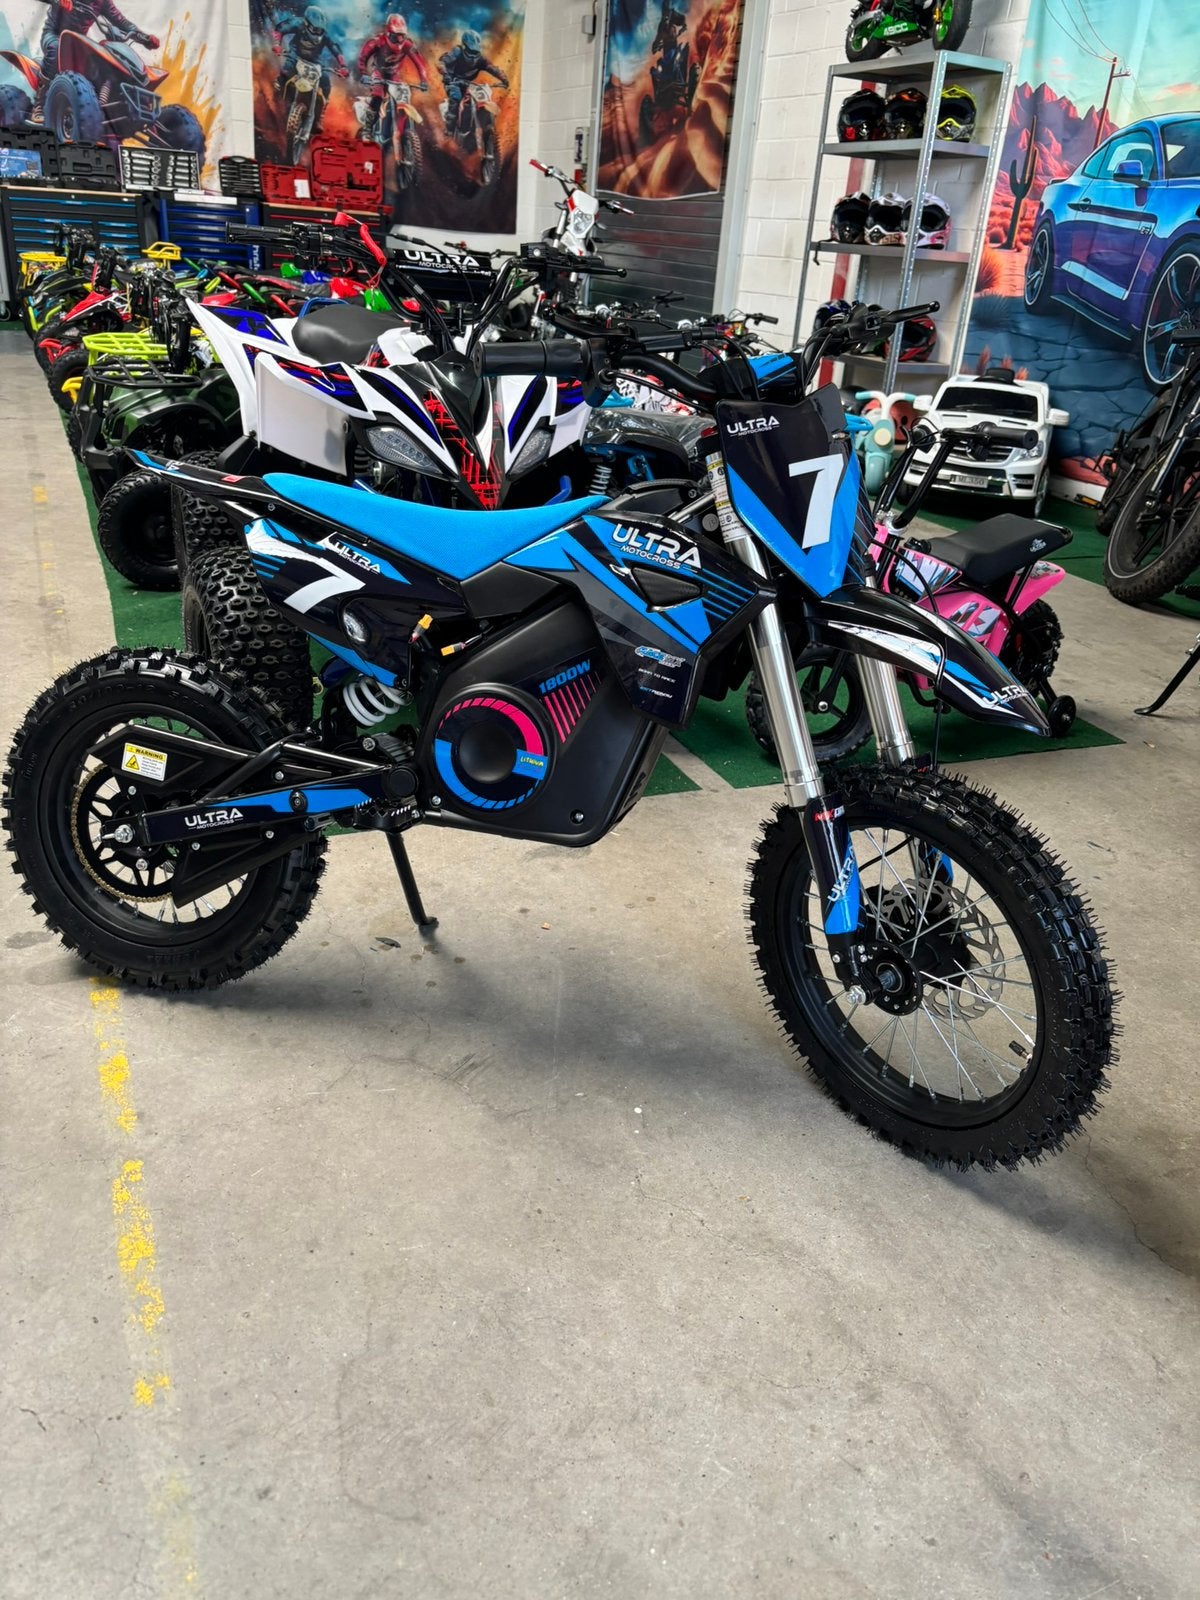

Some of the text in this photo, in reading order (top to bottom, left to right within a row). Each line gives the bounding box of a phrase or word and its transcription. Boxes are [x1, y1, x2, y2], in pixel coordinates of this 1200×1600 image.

[403, 249, 480, 267] ULTRA
[726, 415, 780, 434] ULTRA
[738, 426, 773, 437] MOTOCROSS
[788, 453, 844, 549] 7
[612, 523, 702, 569] ULTRA
[333, 541, 381, 573] ULTRA
[620, 545, 682, 570] MOTOCROSS
[539, 658, 591, 695] 1800W
[135, 748, 164, 761] WARNING
[184, 807, 244, 827] ULTRA
[196, 819, 235, 830] MOTOCROSS
